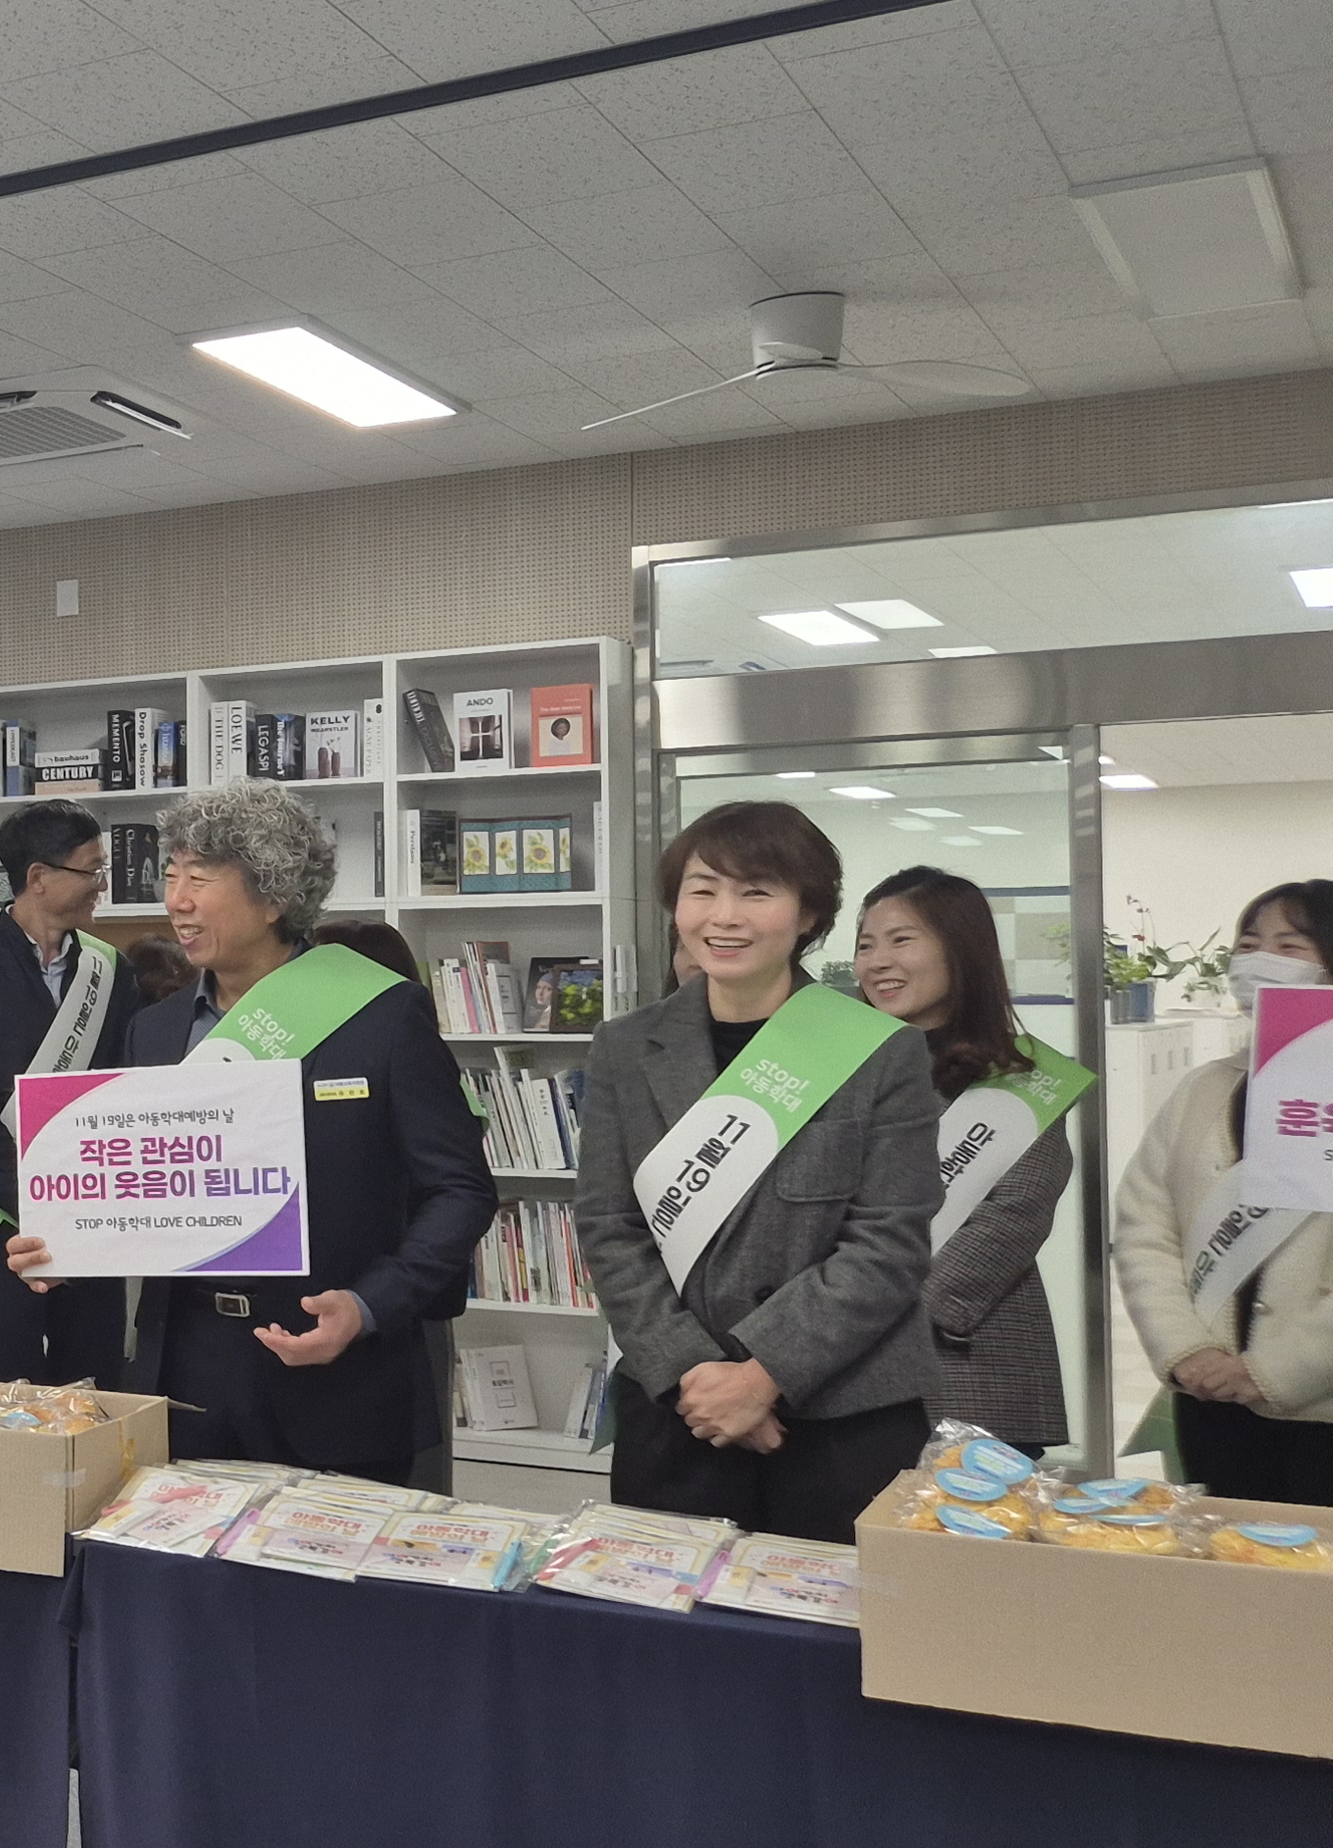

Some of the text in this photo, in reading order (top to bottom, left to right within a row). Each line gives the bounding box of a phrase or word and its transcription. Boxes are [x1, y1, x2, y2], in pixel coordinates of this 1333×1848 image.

[466, 697, 494, 707] ANDO
[137, 712, 147, 739] Drop
[231, 706, 243, 755] LOEWE
[310, 715, 351, 726] KELLY
[112, 714, 121, 763] MEMENTO
[257, 725, 270, 771] LEGASPI
[42, 766, 94, 781] CENTURY
[54, 754, 89, 763] bauhaus
[215, 745, 224, 771] DOG
[252, 1007, 296, 1044] stop!
[739, 1067, 803, 1113] 아동학대
[755, 1058, 811, 1095] stop!
[74, 1108, 235, 1130] 11월 19일은 아동학대예방의 날
[79, 1134, 223, 1167] 작은 관심이
[695, 1113, 752, 1170] 11월
[29, 1165, 292, 1202] 아이의 웃음이 됩니다
[74, 1214, 243, 1232] STOP 아동학대 LOVE CHILDREN
